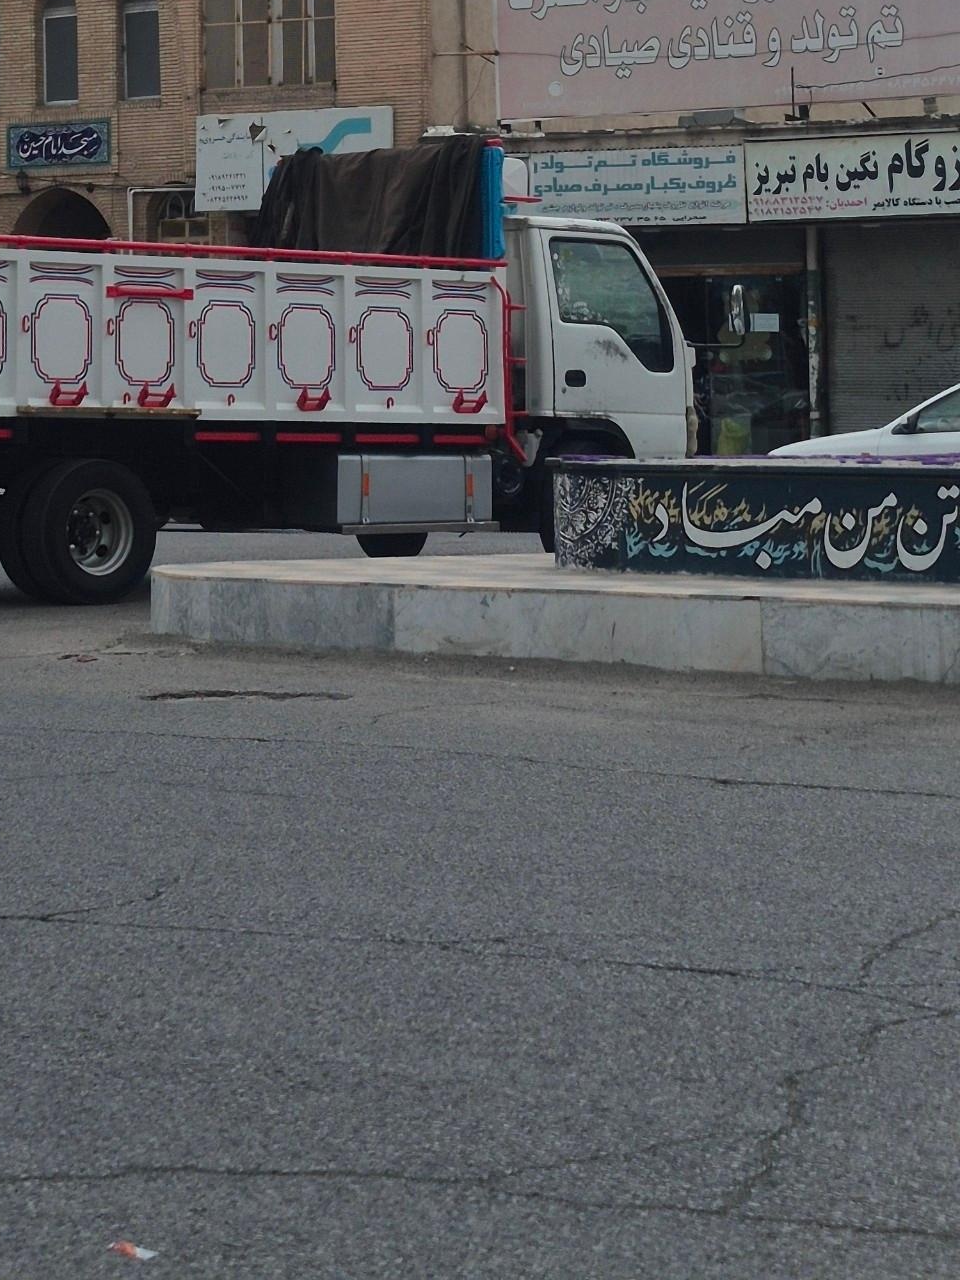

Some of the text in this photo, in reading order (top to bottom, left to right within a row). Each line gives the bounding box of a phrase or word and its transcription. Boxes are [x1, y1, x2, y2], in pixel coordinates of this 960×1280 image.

[560, 4, 904, 80] تم تولد و قنادی صیادی
[43, 134, 62, 160] امام
[60, 132, 98, 155] مسجد
[540, 154, 593, 174] تولد
[595, 154, 637, 171] تم
[641, 150, 736, 170] فروشگاه
[835, 150, 879, 191] نگین
[688, 173, 737, 193] ظروف
[753, 156, 797, 195] تبریز
[802, 153, 829, 193] بام
[584, 179, 643, 196] مصرف
[645, 176, 687, 195] یکبار
[651, 481, 822, 570] مباد
[825, 492, 897, 569] من
